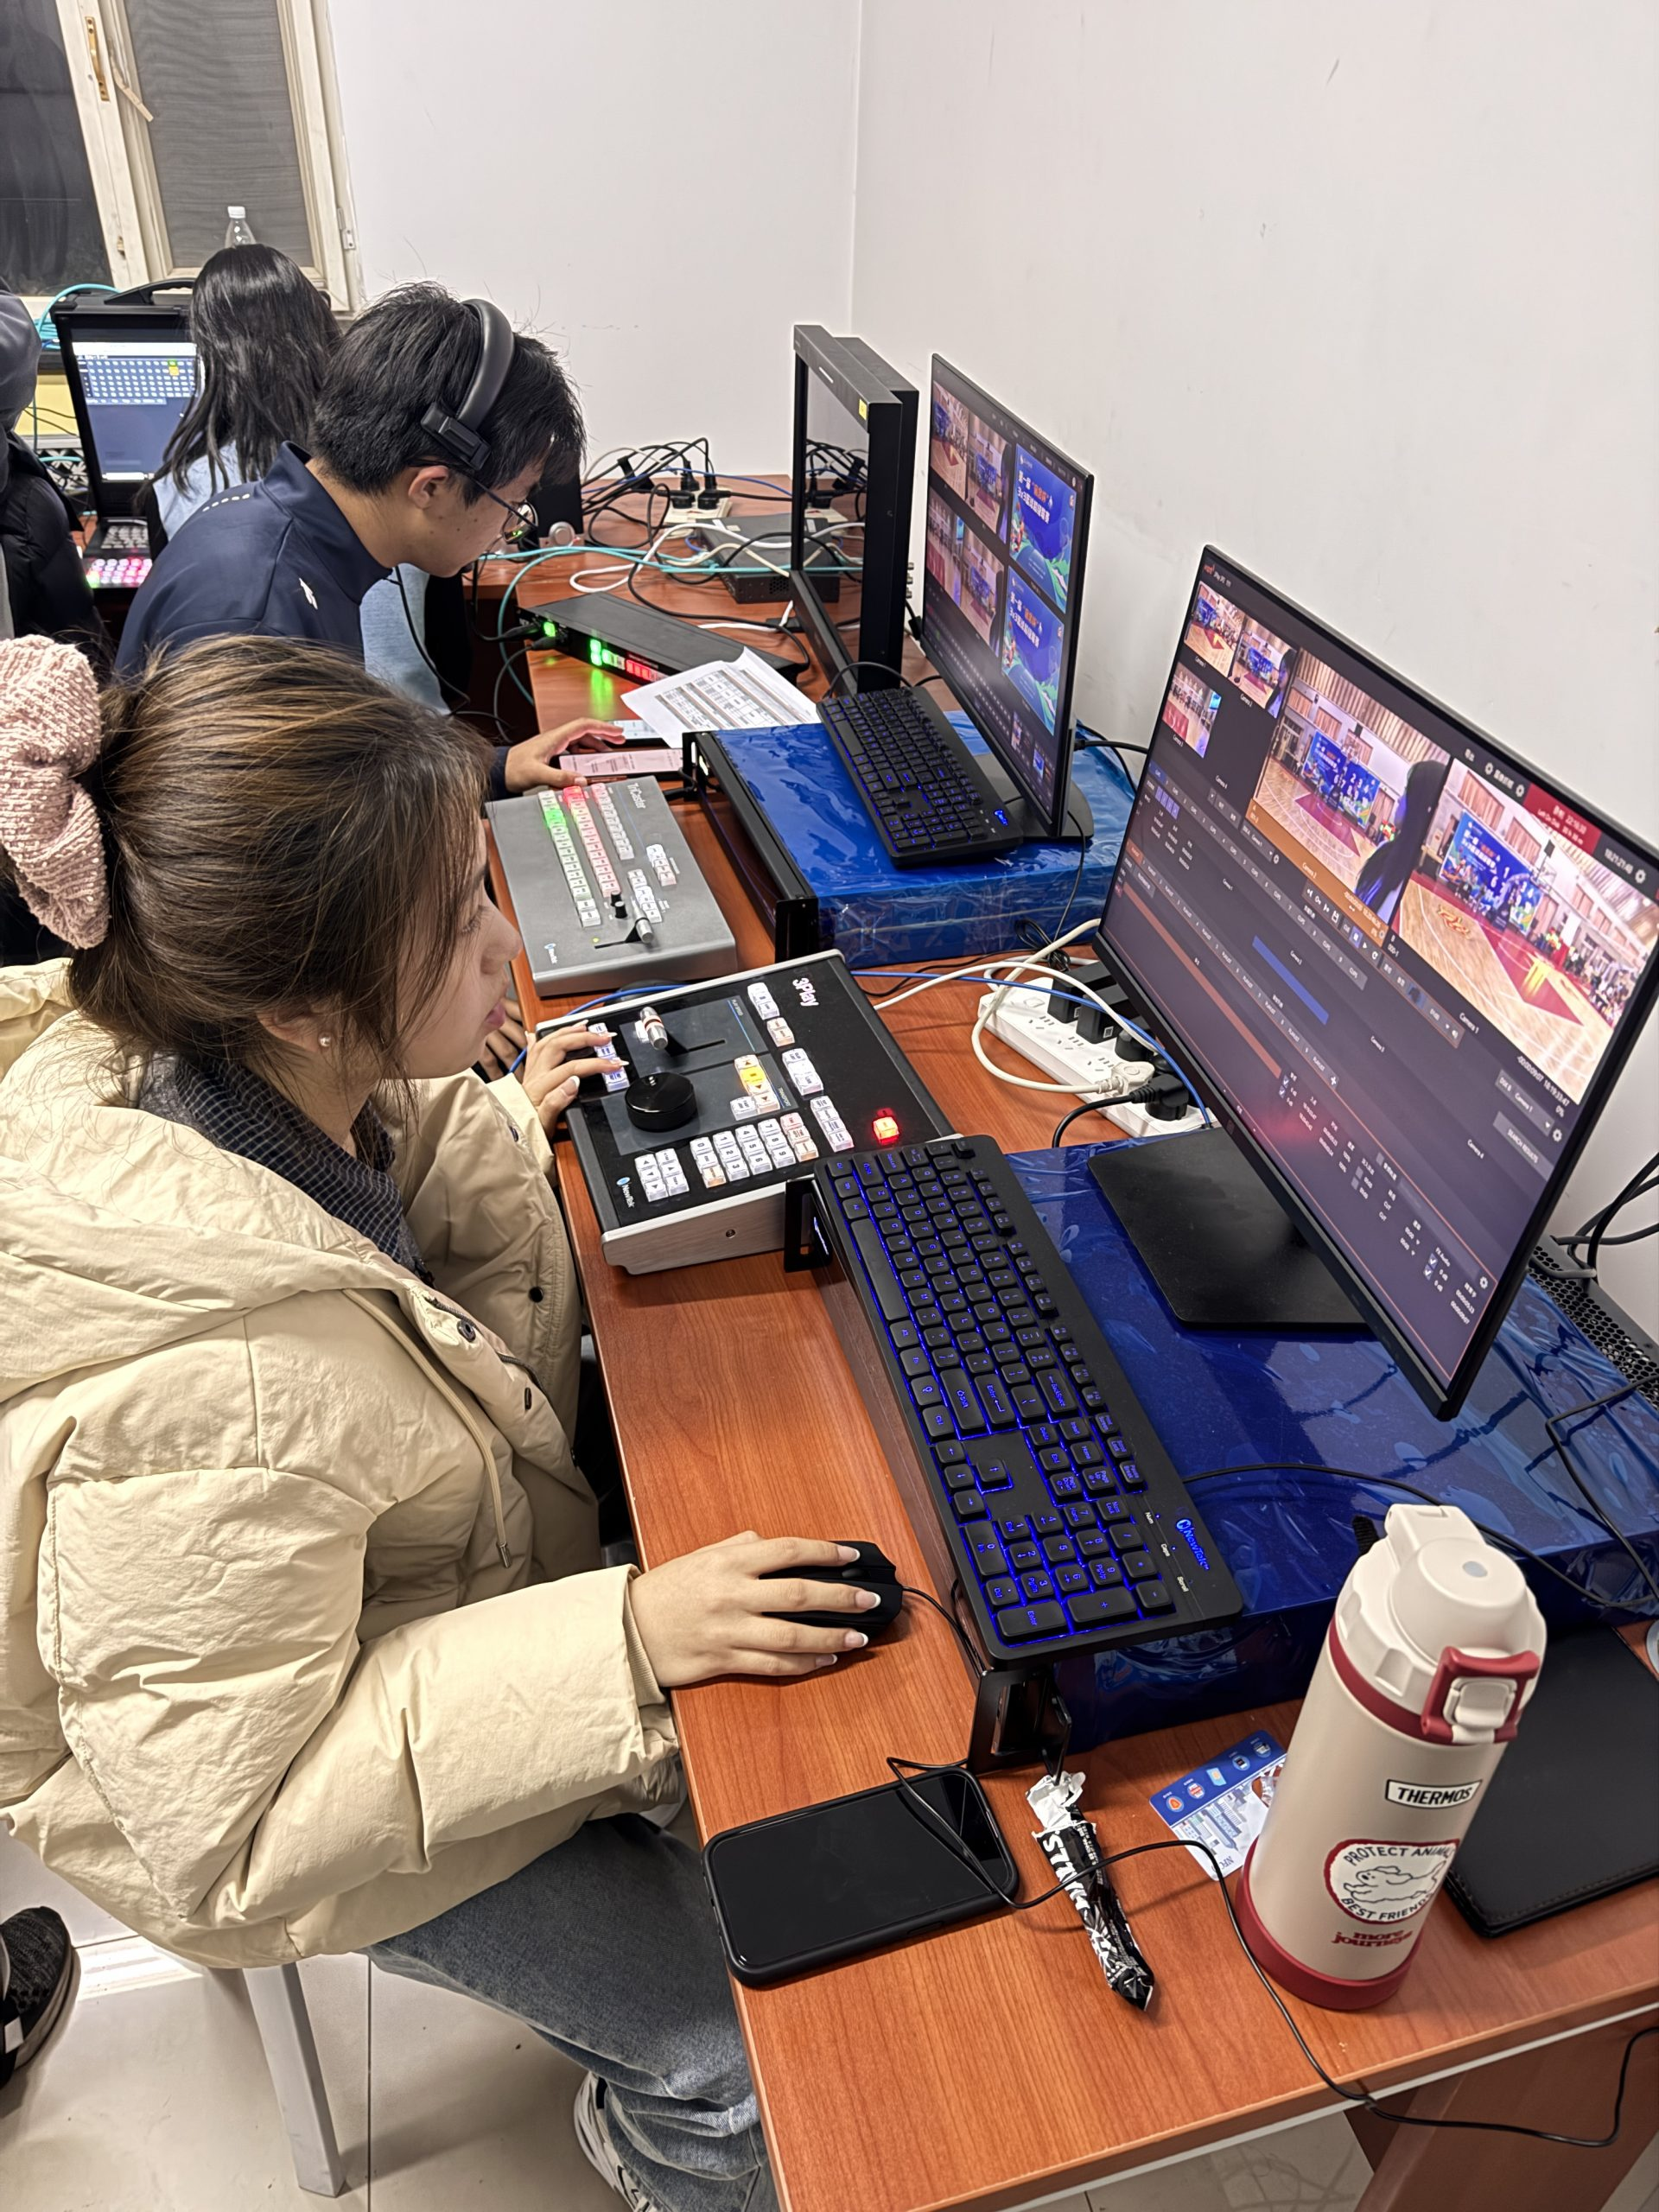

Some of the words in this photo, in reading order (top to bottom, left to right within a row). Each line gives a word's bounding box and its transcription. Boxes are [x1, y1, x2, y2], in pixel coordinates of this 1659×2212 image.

[627, 783, 646, 809] TriCaster
[792, 977, 819, 1007] 3Play
[1459, 1012, 1476, 1031] Camera
[1515, 1092, 1529, 1110] Camera
[621, 1183, 635, 1207] NewTek
[987, 1384, 996, 1398] Enter
[1082, 1446, 1091, 1459] Home
[1071, 1507, 1079, 1522] Home
[1106, 1503, 1115, 1514] Lock
[1145, 1512, 1154, 1524] Num
[1006, 1522, 1014, 1532] End
[1160, 1543, 1170, 1556] Caps
[1096, 1564, 1107, 1580] PgUp
[1177, 1576, 1189, 1592] Scroll
[1398, 1787, 1472, 1805] THERMOS
[1221, 1856, 1234, 1870] NFC
[1344, 1846, 1408, 1866] PROTECT
[1411, 1846, 1454, 1859] ANIMA
[1341, 1897, 1376, 1919] BEST
[1379, 1896, 1429, 1920] FRIEND
[1353, 1929, 1404, 1940] more
